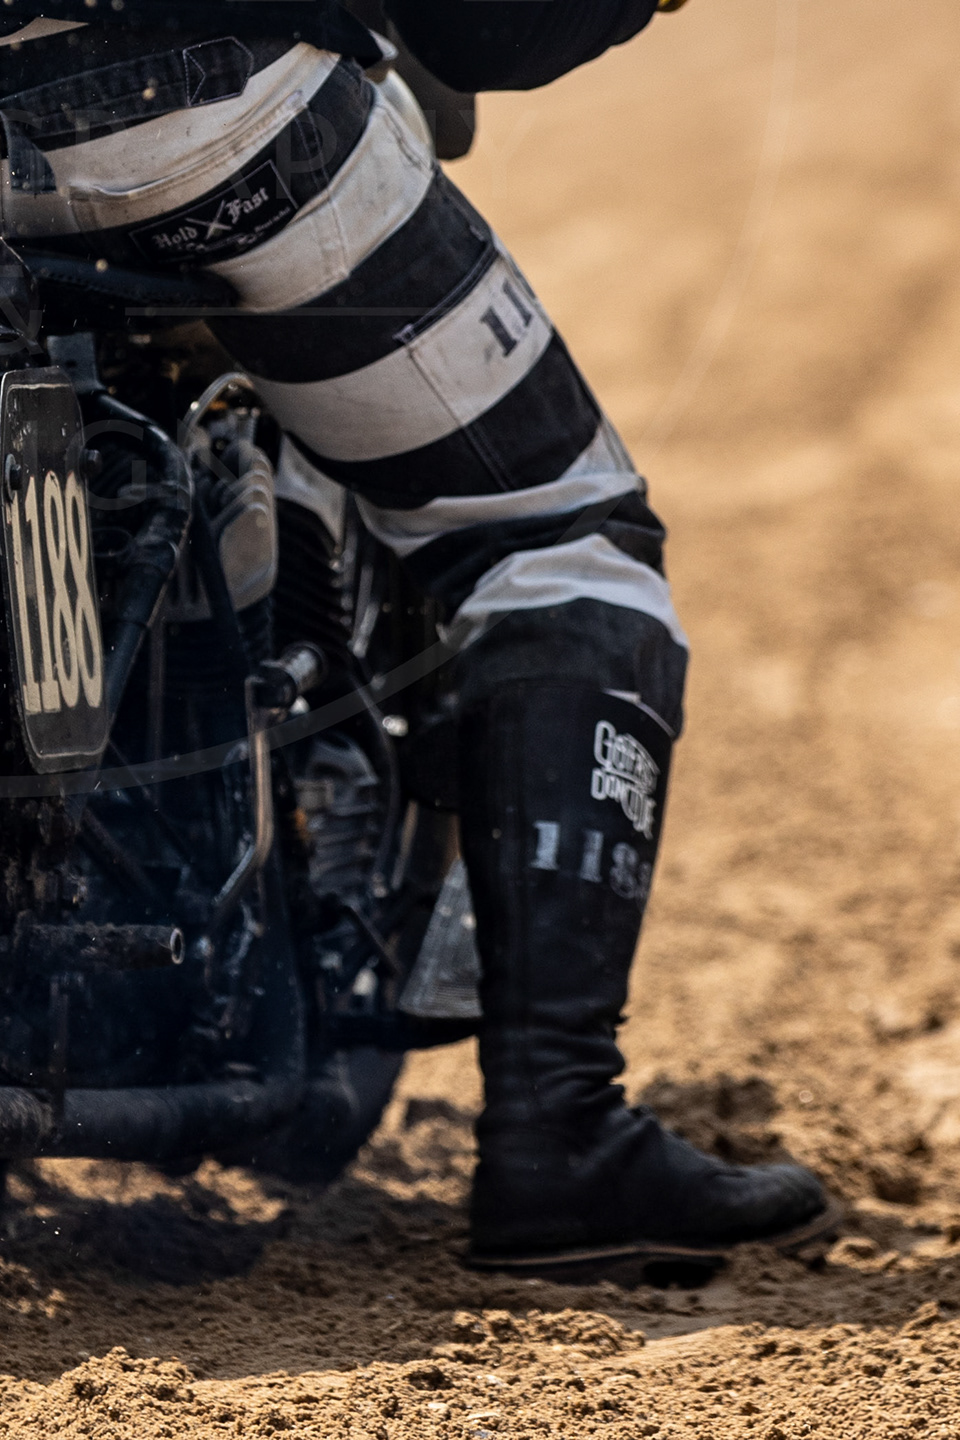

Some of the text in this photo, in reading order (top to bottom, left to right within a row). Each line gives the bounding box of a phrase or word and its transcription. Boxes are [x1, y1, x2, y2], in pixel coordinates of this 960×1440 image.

[151, 225, 198, 250] Hold
[225, 186, 270, 225] Fast
[5, 469, 104, 714] 1188
